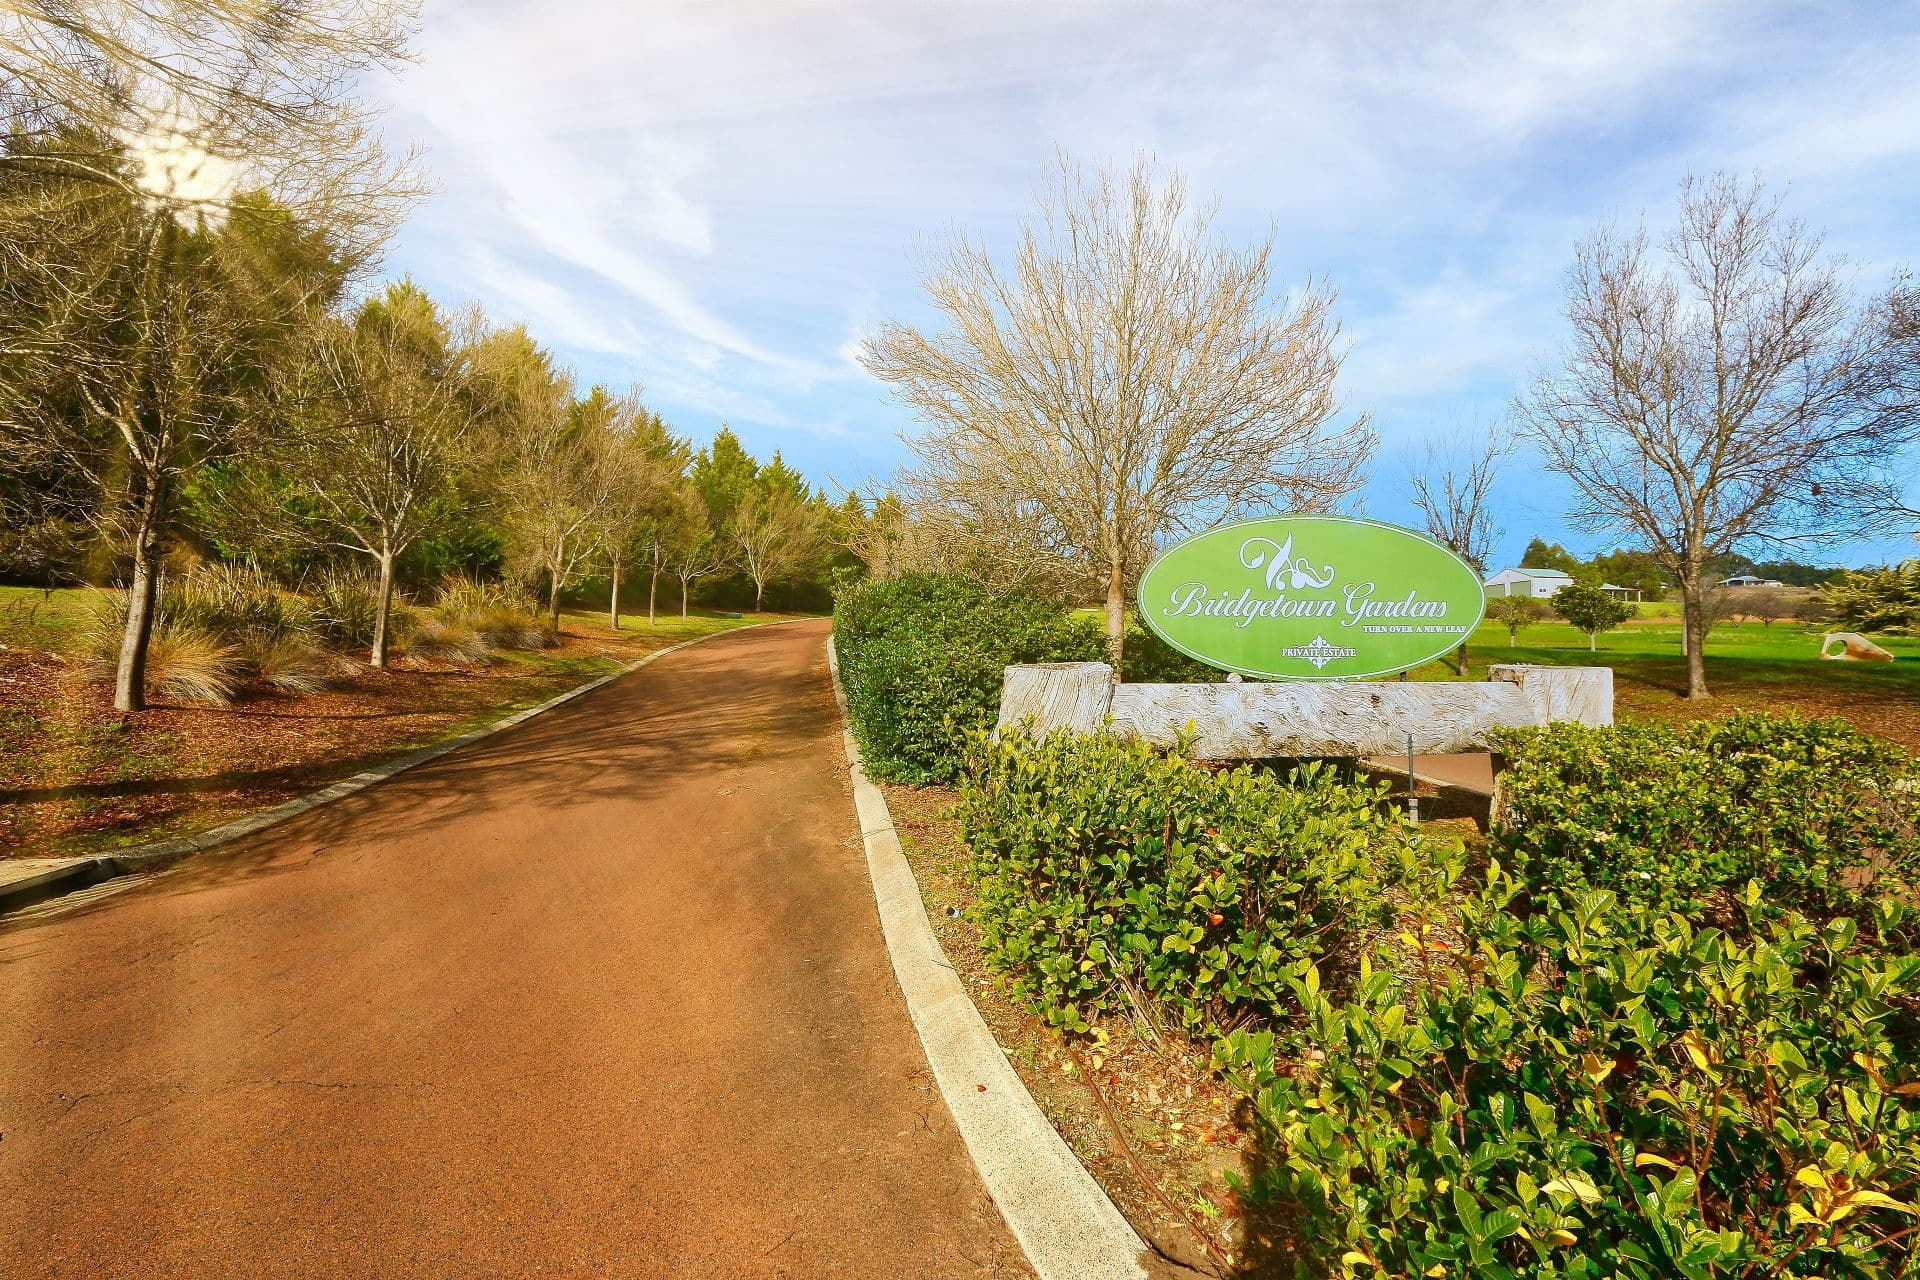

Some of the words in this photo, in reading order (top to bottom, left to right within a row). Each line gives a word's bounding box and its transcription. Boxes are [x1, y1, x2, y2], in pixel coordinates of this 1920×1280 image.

[1163, 581, 1338, 628] Bridgetown
[1341, 581, 1448, 627] Gardens
[1363, 625, 1389, 633] TURN
[1390, 625, 1412, 633] OVER
[1416, 625, 1423, 633] A
[1424, 625, 1443, 633] NEW
[1445, 625, 1467, 633] LEAF
[1282, 648, 1320, 657] PRIVATE
[1322, 648, 1356, 657] ESTATE
